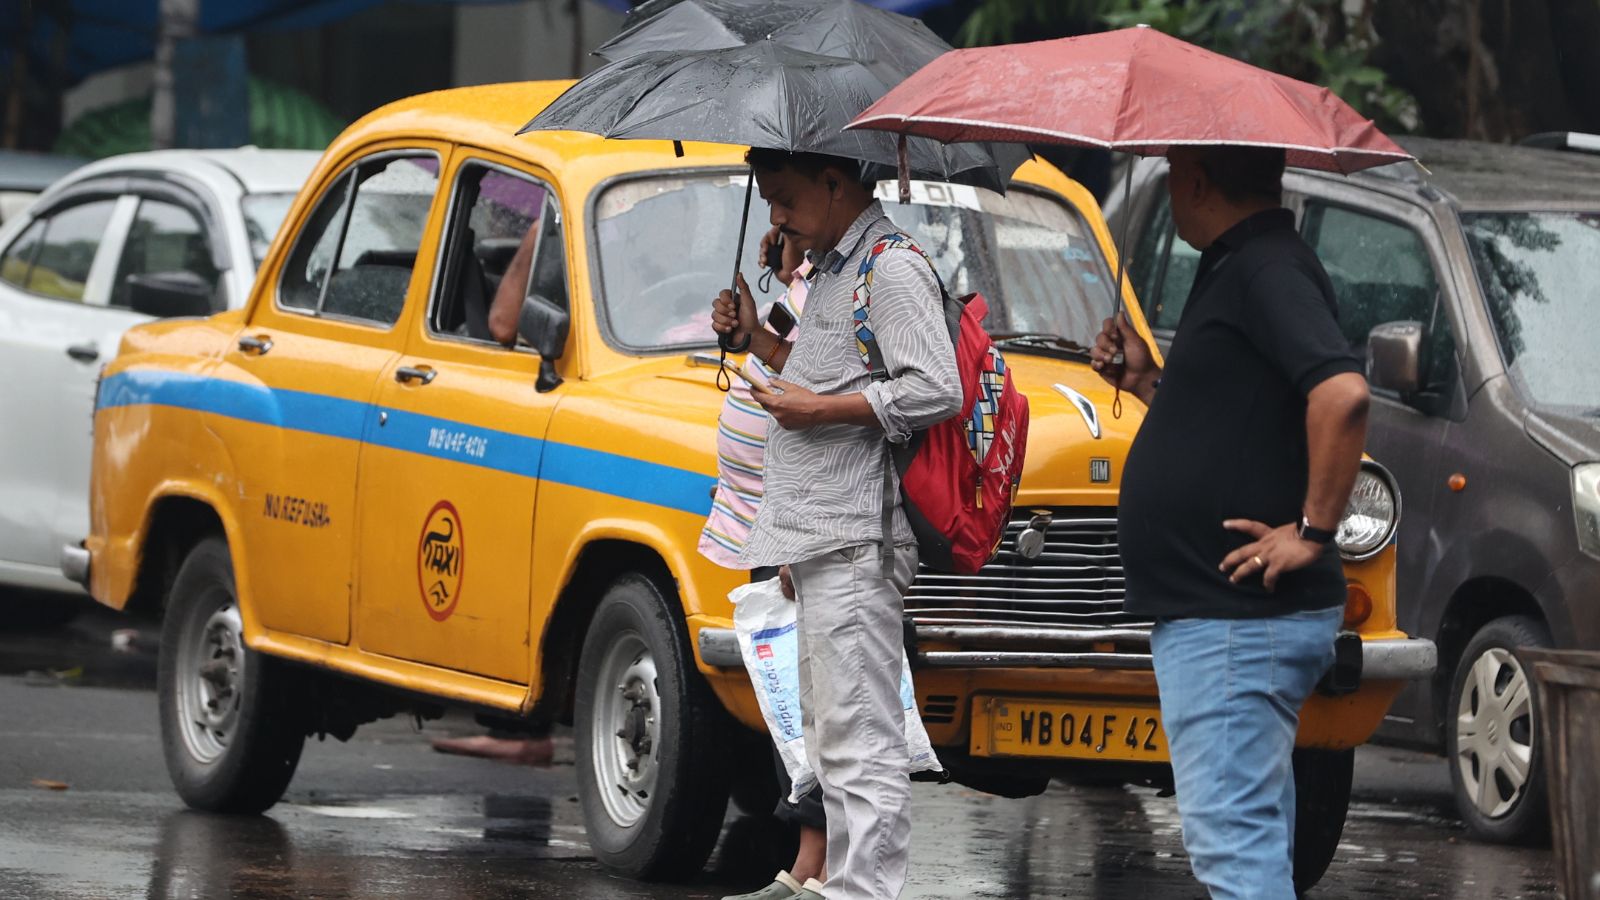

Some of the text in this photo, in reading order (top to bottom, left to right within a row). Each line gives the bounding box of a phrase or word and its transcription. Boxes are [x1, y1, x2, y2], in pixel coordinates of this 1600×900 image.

[264, 493, 281, 519] NO
[423, 517, 459, 576] TAXI
[764, 661, 781, 694] store
[778, 699, 794, 736] super
[1021, 711, 1158, 751] WB04F42
